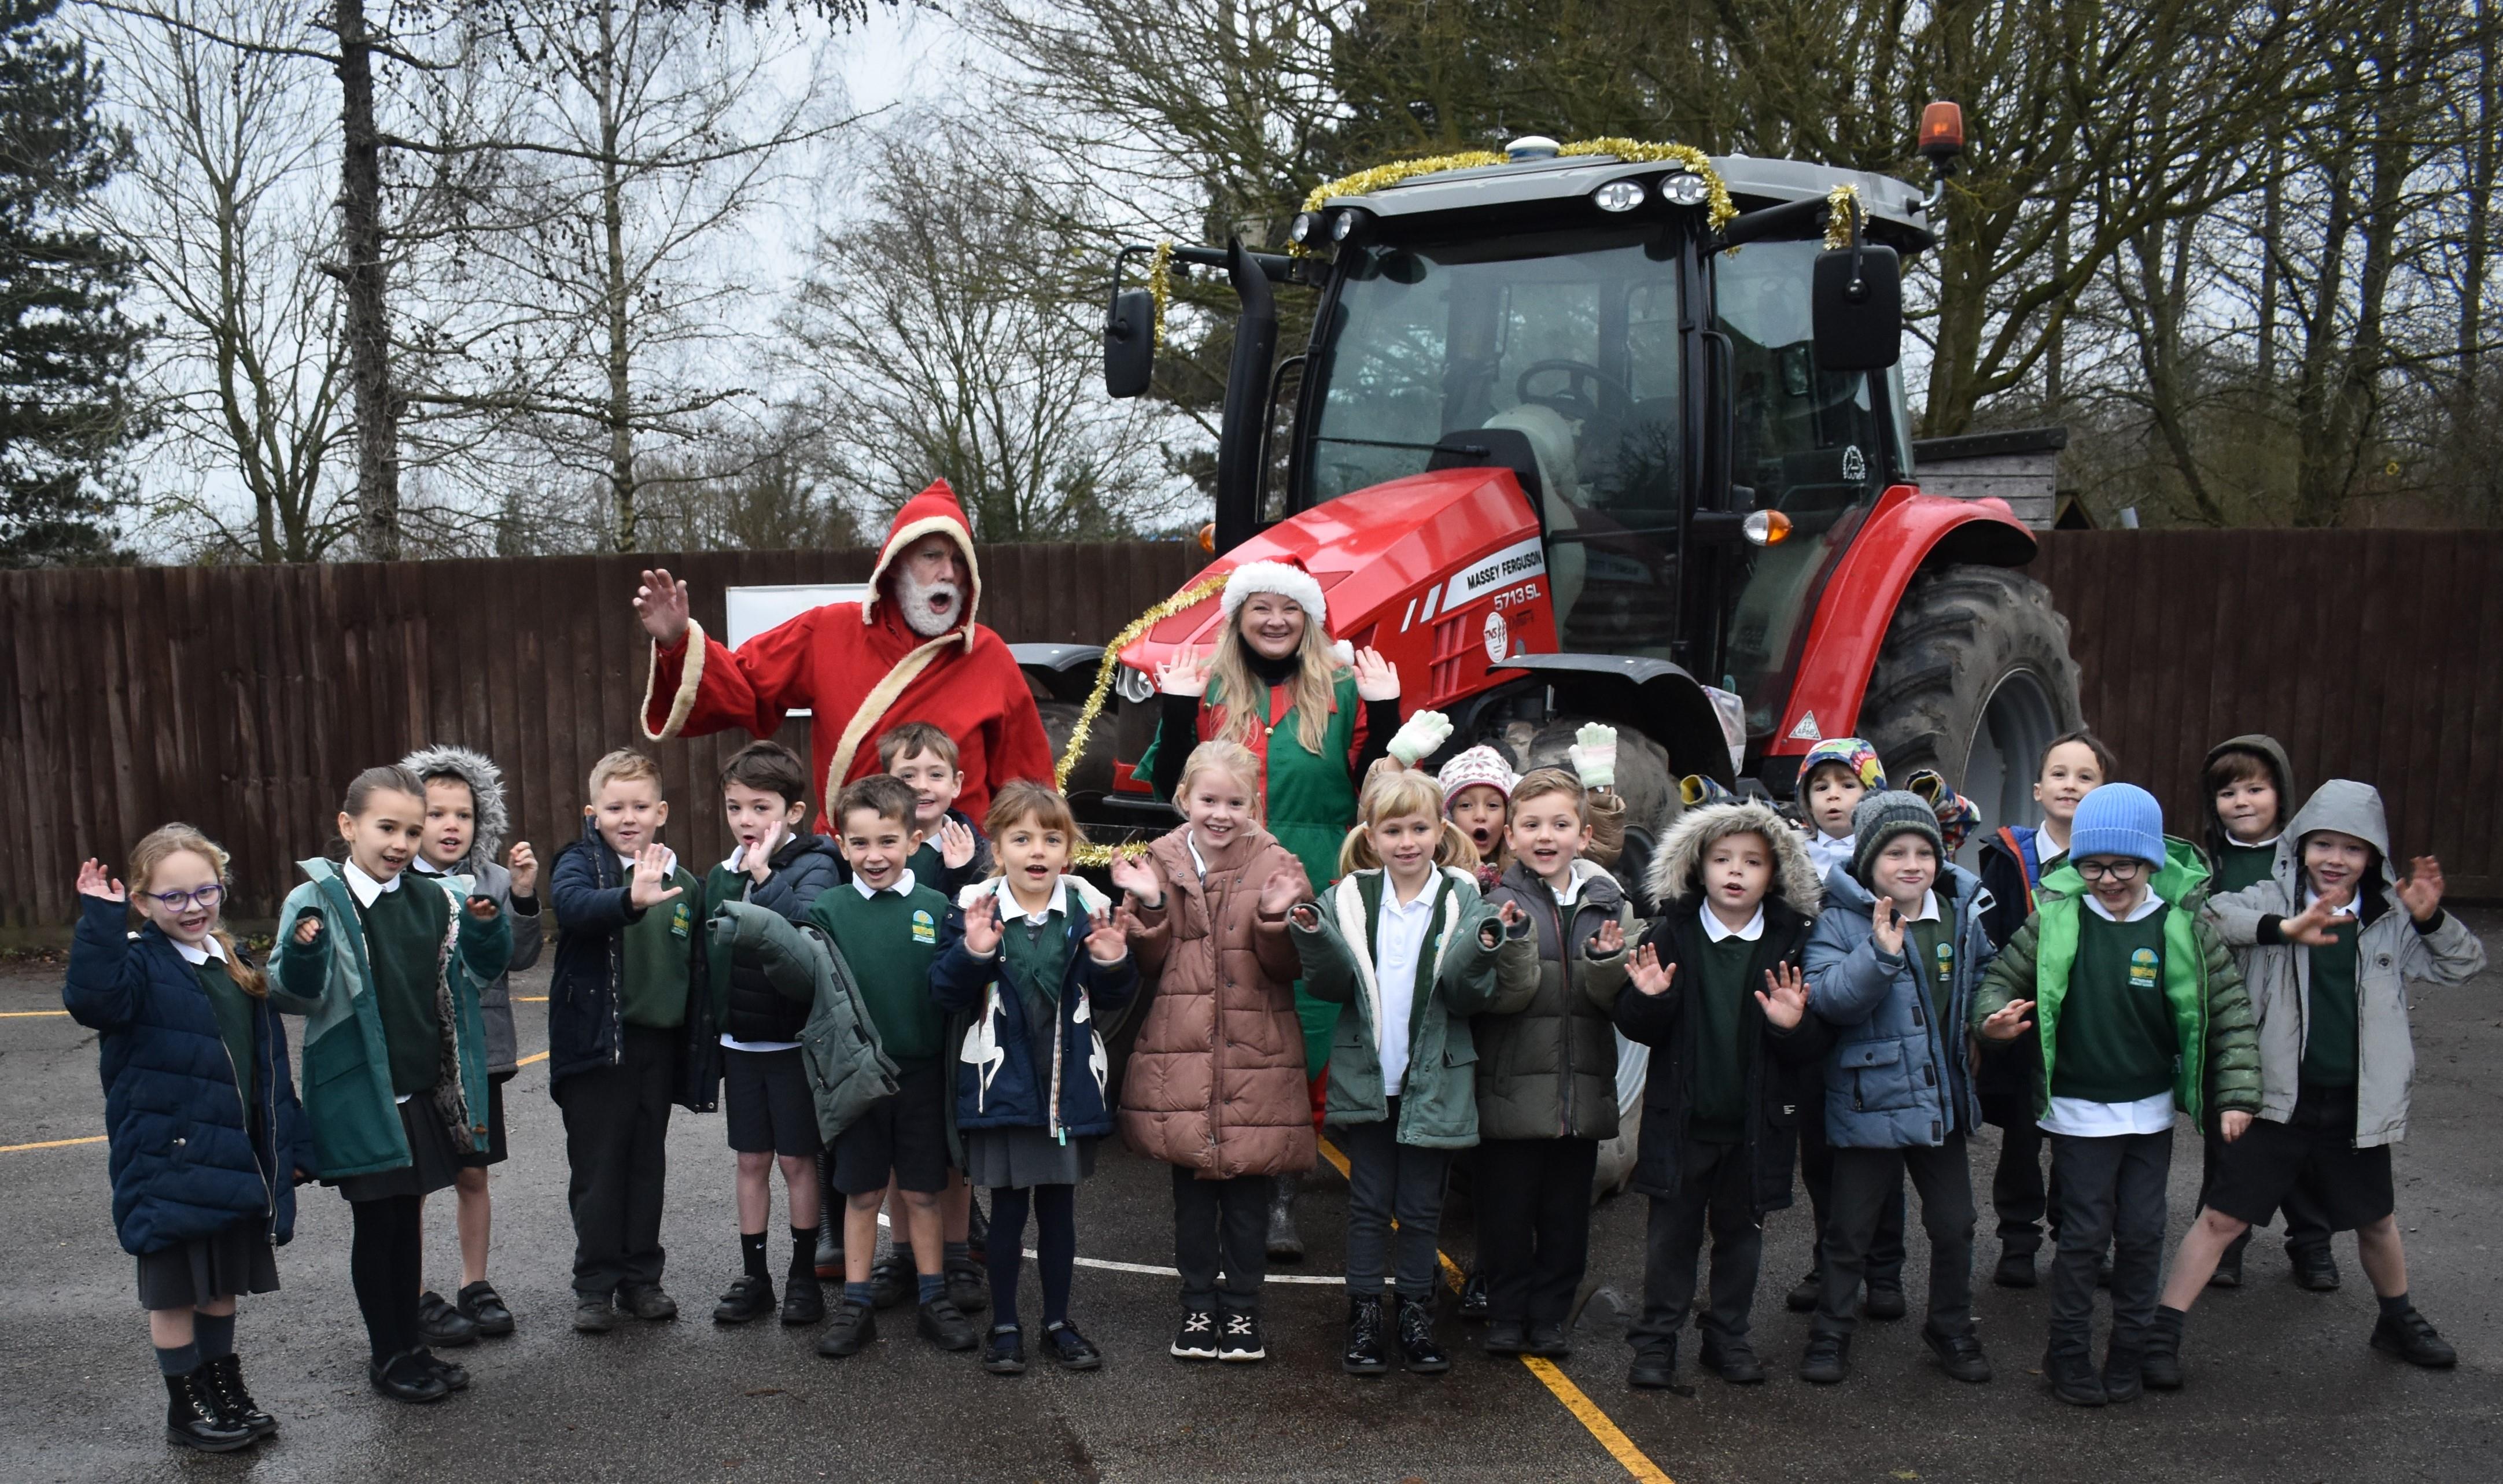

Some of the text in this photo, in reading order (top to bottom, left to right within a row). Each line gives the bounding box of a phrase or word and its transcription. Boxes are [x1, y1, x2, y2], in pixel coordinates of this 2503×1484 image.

[1467, 550, 1542, 590] MASSEY FERGUSON
[1494, 583, 1541, 611] 5713 SL
